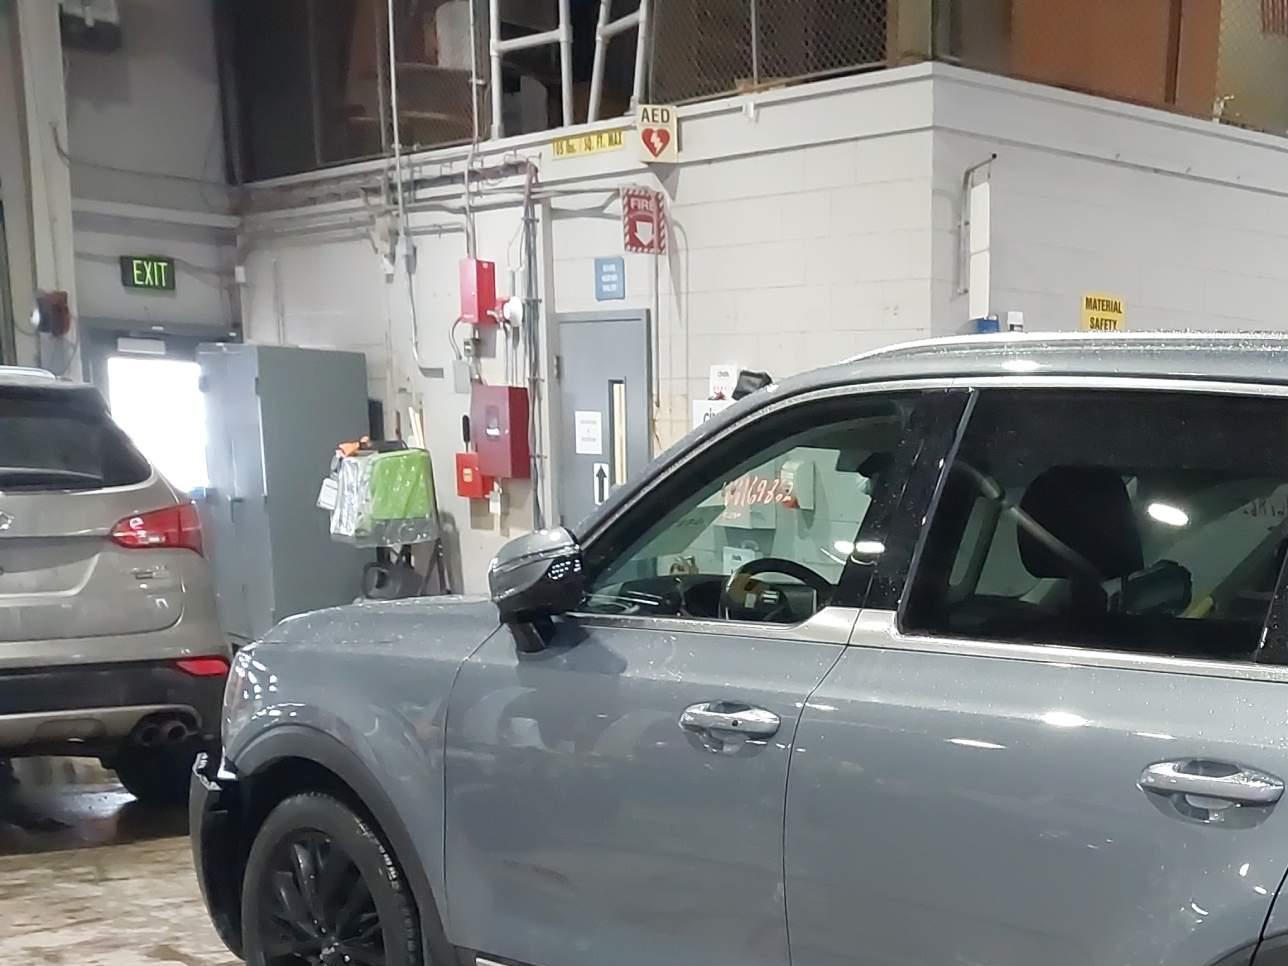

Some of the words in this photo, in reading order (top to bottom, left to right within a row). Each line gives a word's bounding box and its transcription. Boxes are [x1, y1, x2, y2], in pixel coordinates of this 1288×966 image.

[641, 107, 670, 123] AED
[132, 260, 168, 287] EXIT
[1085, 296, 1122, 314] MATERIAL
[1090, 316, 1118, 331] SAFETY
